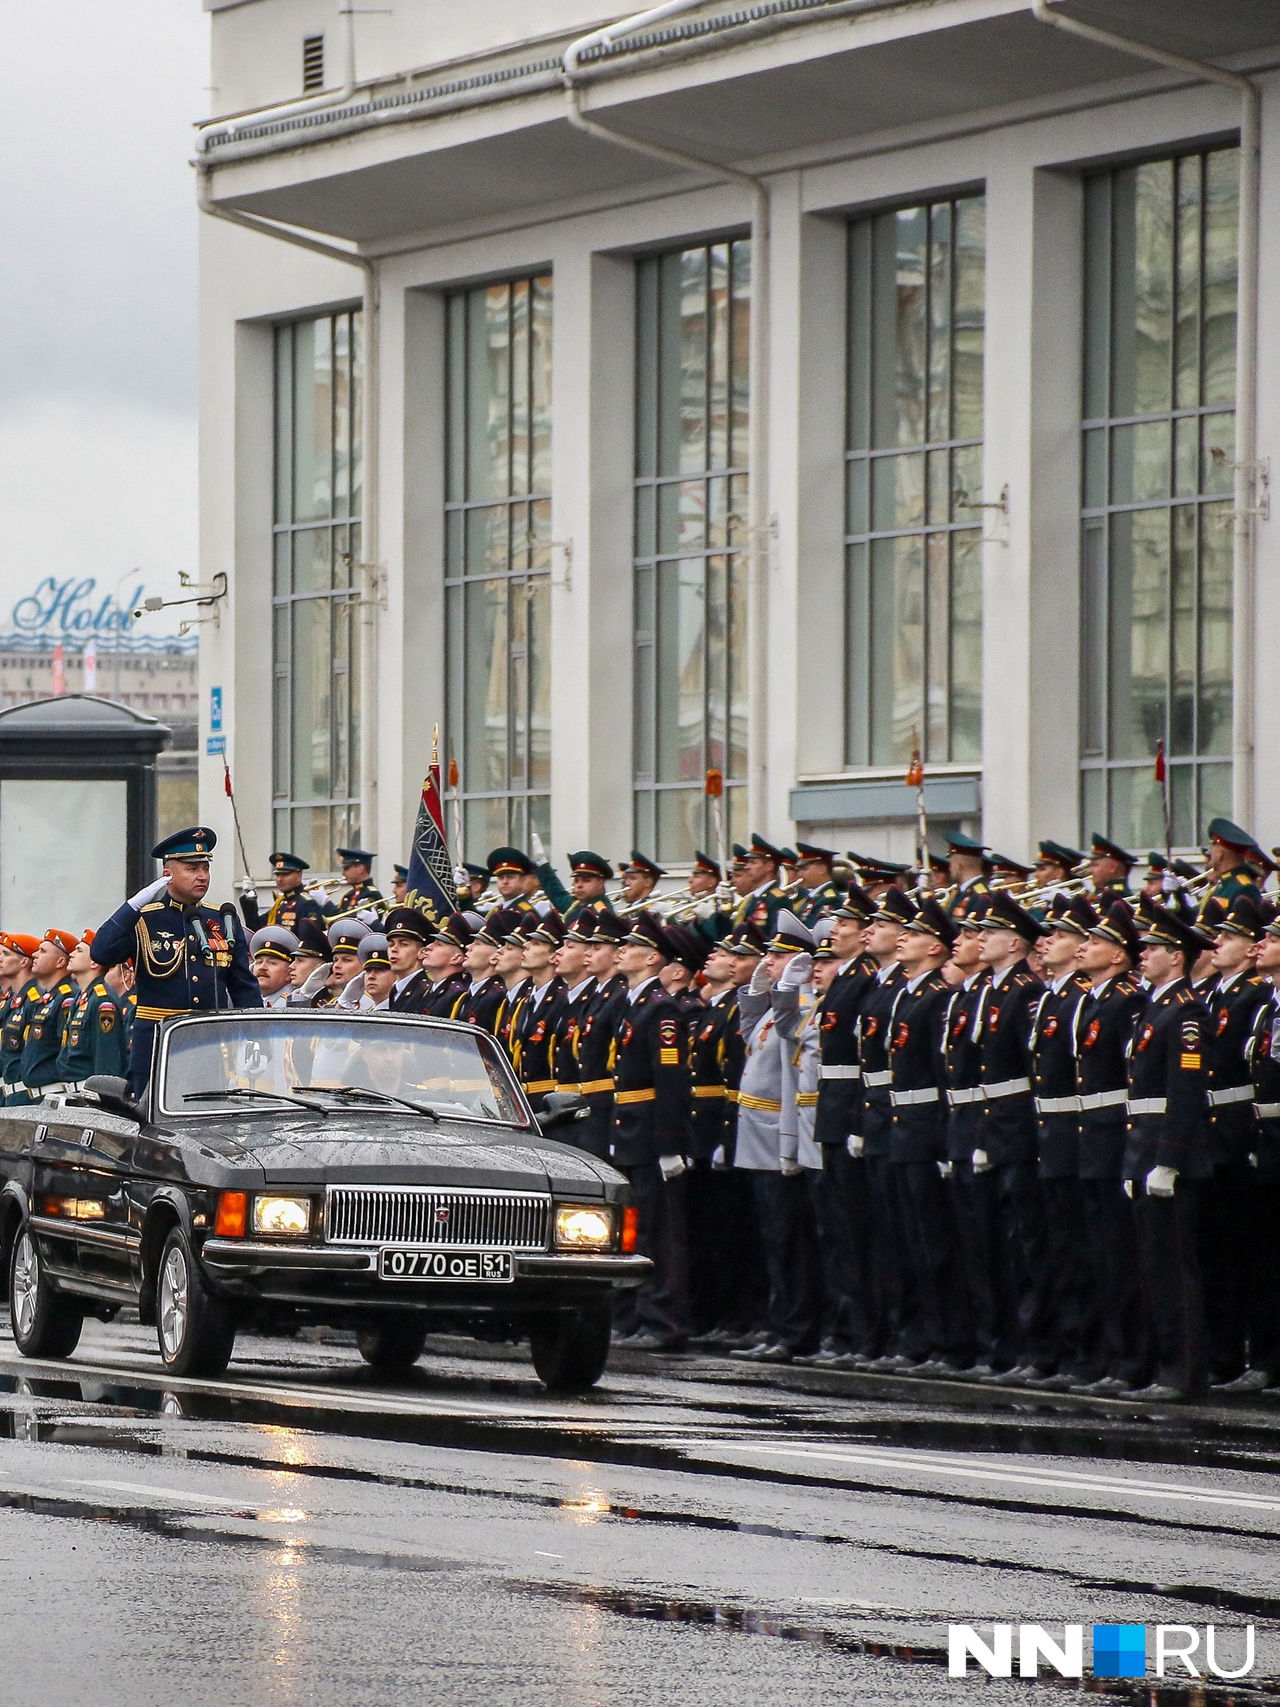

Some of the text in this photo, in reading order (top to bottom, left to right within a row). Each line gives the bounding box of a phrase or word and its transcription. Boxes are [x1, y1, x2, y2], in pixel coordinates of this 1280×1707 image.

[13, 575, 145, 631] Hotel
[391, 1252, 447, 1276] 0770
[482, 1254, 505, 1272] 51
[485, 1270, 502, 1278] RUS
